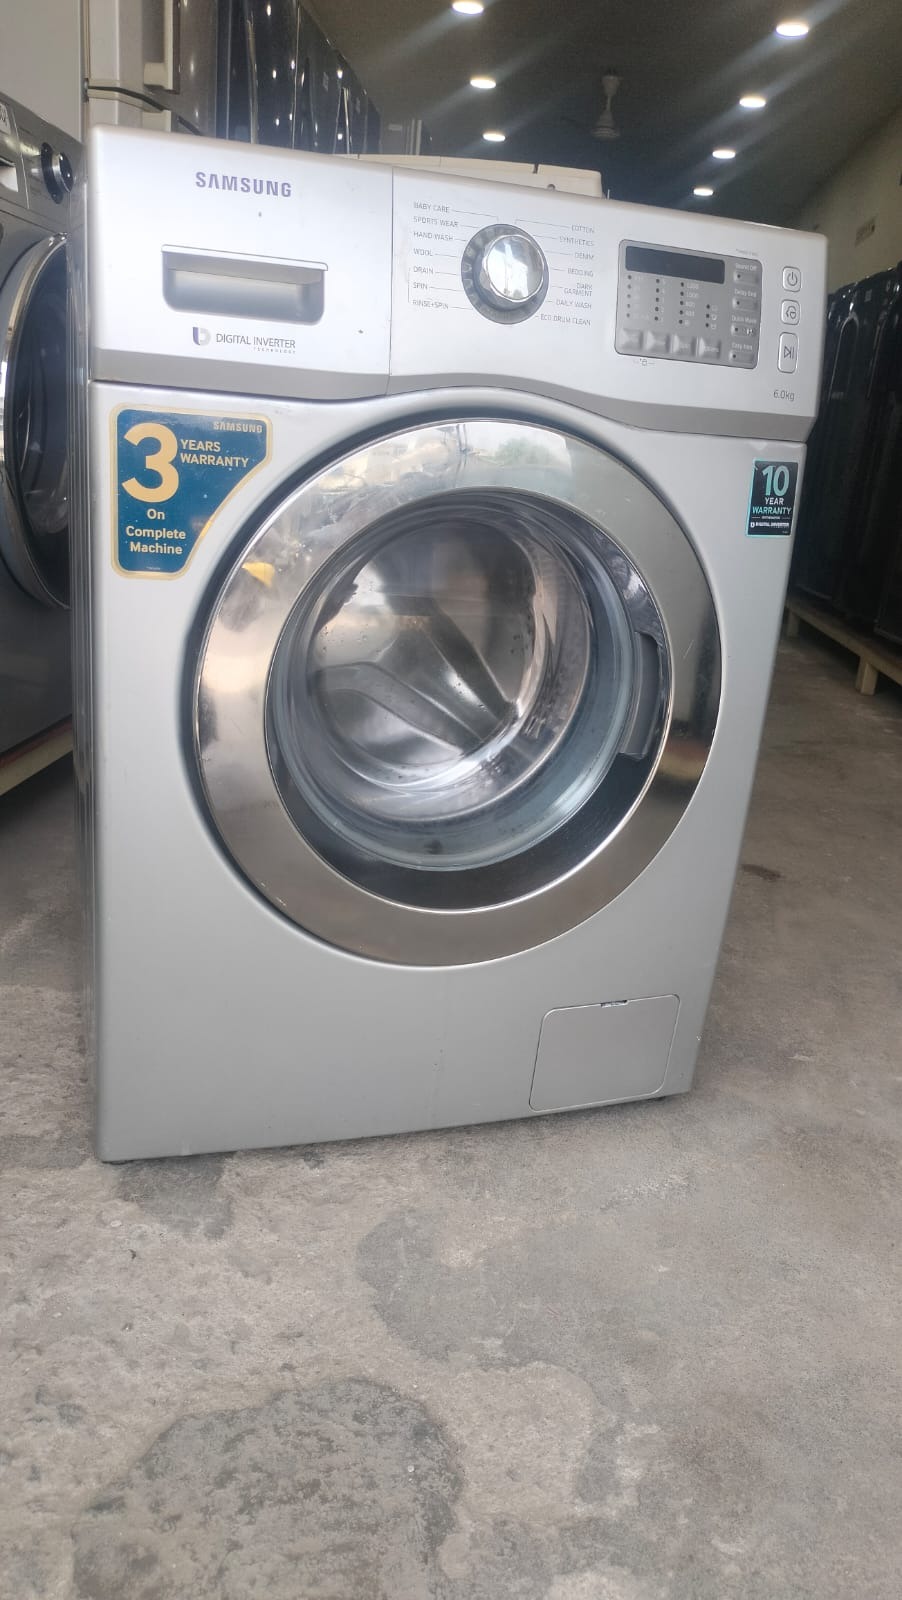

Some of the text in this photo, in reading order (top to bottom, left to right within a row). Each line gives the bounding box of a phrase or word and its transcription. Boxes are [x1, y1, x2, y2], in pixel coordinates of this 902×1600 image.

[195, 171, 292, 198] SAMSUNG
[413, 202, 450, 213] BABY CARE
[413, 216, 459, 227] SPORTS WEAR
[571, 225, 594, 234] COTTON
[413, 231, 454, 241] HAND WASH
[560, 236, 595, 247] SYNTHETICS
[413, 248, 433, 257] WOOL
[574, 252, 594, 260] DENIM
[413, 266, 434, 274] DRAIN
[567, 267, 594, 277] BEDDING
[413, 282, 428, 290] SPIN
[576, 282, 593, 290] DARK
[563, 287, 593, 297] GARMENT
[412, 299, 449, 310] RINSE+SPIN
[556, 299, 592, 309] DAILY WASH
[540, 313, 591, 326] ECO DRUM CLEAN
[216, 333, 296, 349] DIGITAL INVERTER
[773, 389, 795, 402] 6.0kg
[213, 421, 263, 433] SAMSUNG
[180, 439, 221, 452] YEARS
[121, 422, 180, 503] 3
[180, 453, 249, 468] WARRANTY
[762, 465, 790, 497] 10
[764, 497, 784, 505] YEAR
[146, 508, 166, 520] On
[752, 506, 792, 514] WARRANTY
[125, 525, 187, 541] Complete
[130, 541, 183, 555] Machine
